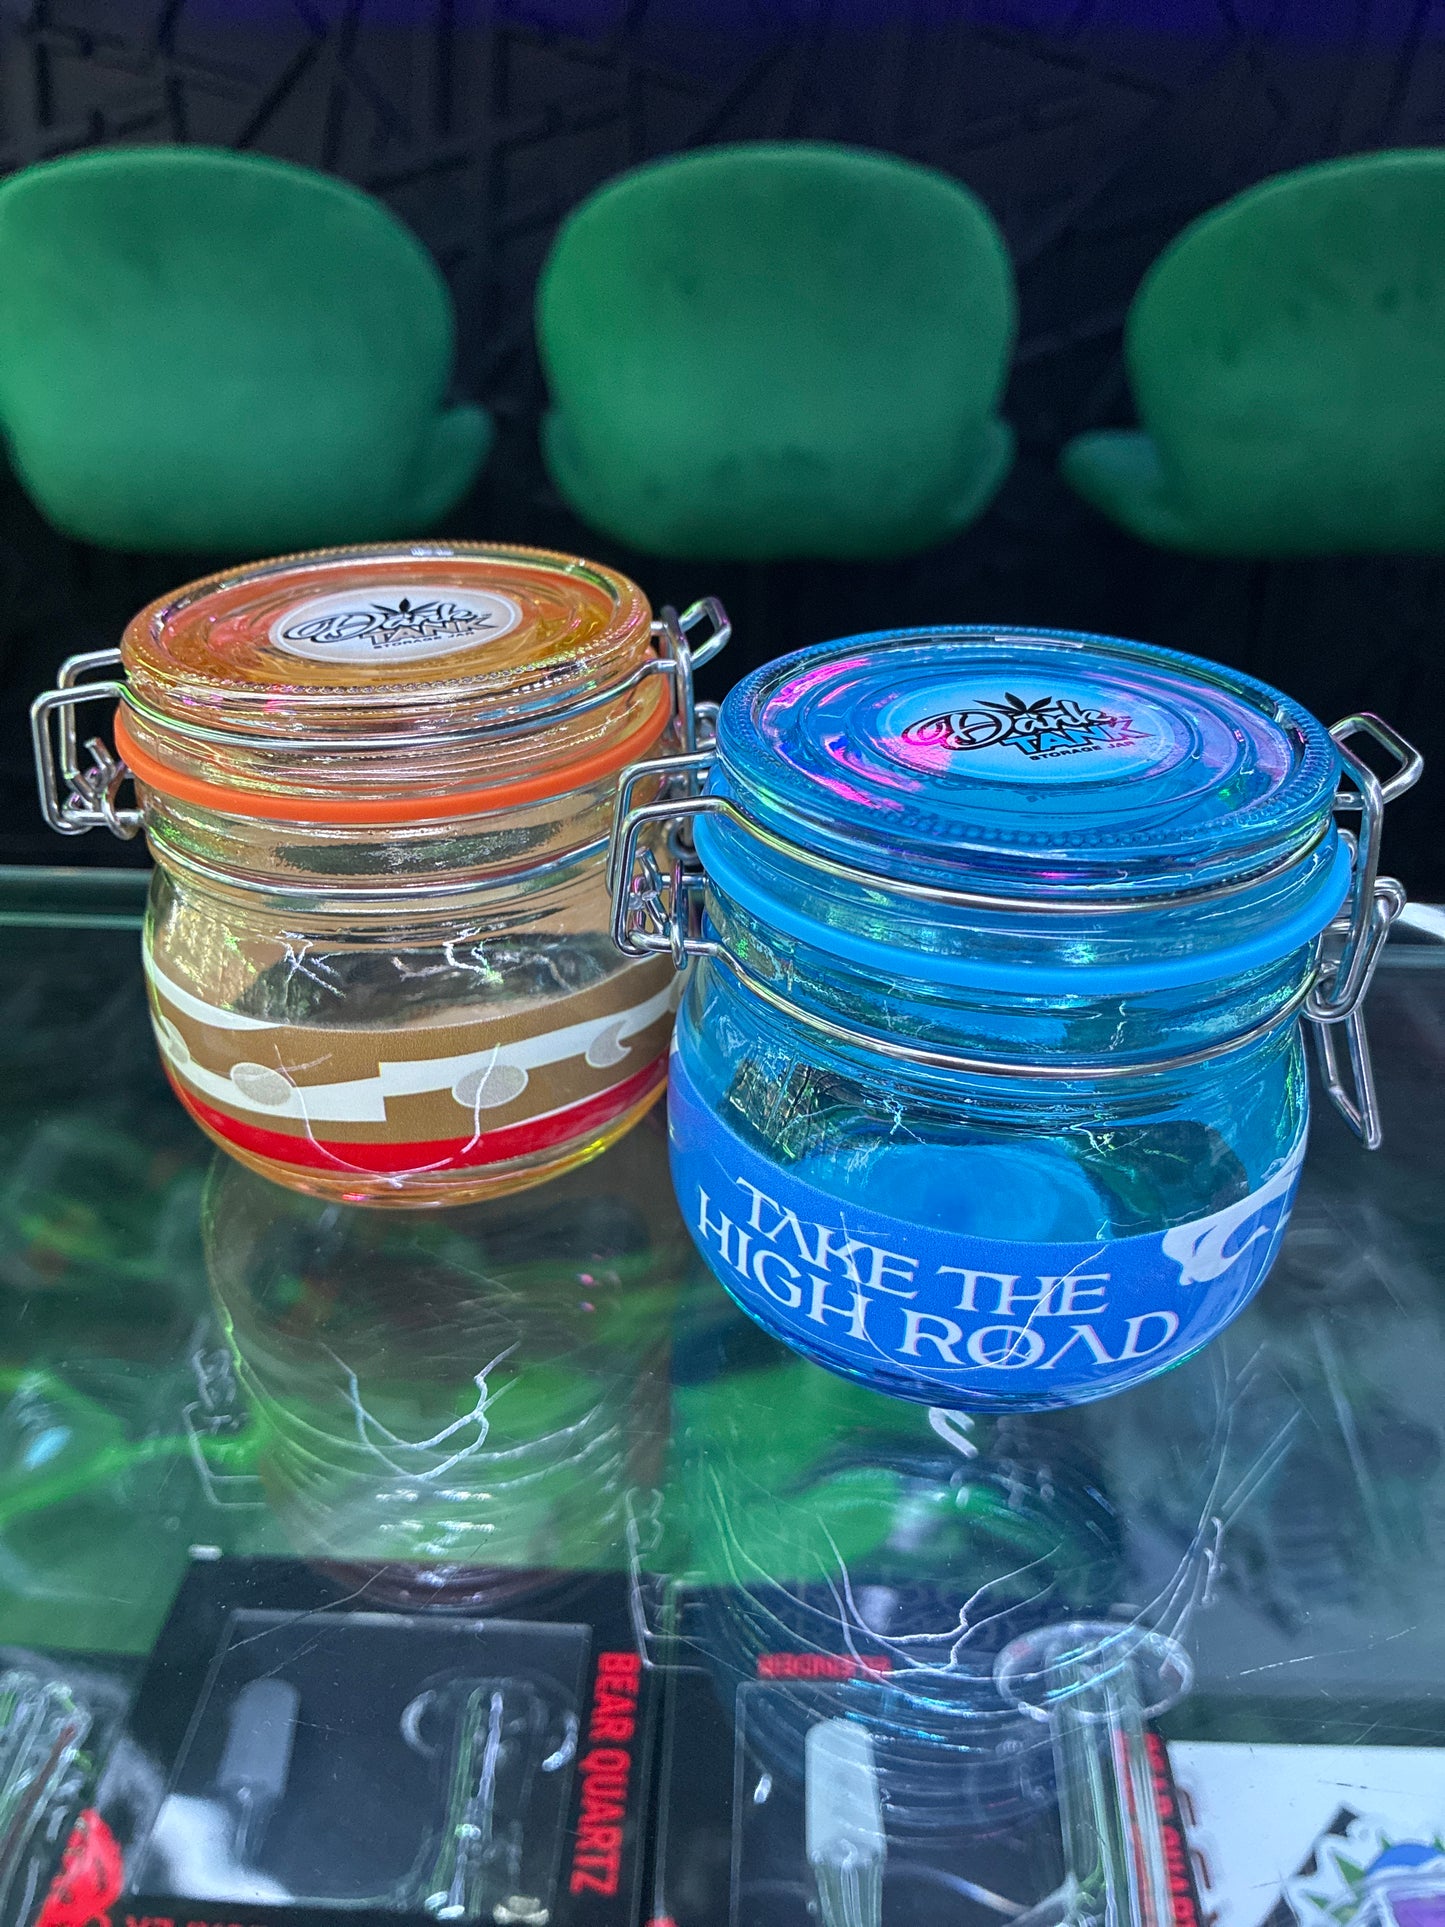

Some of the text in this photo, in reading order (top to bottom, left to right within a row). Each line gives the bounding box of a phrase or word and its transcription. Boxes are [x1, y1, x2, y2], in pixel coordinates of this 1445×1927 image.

[360, 617, 498, 646] TANK
[1003, 718, 1156, 756] TANK
[1028, 740, 1137, 762] STORAGE JAR
[697, 1185, 1179, 1370] HIGH ROAD
[736, 1177, 1112, 1318] TAKE THE
[569, 1652, 642, 1897] BEAR QUARTZ
